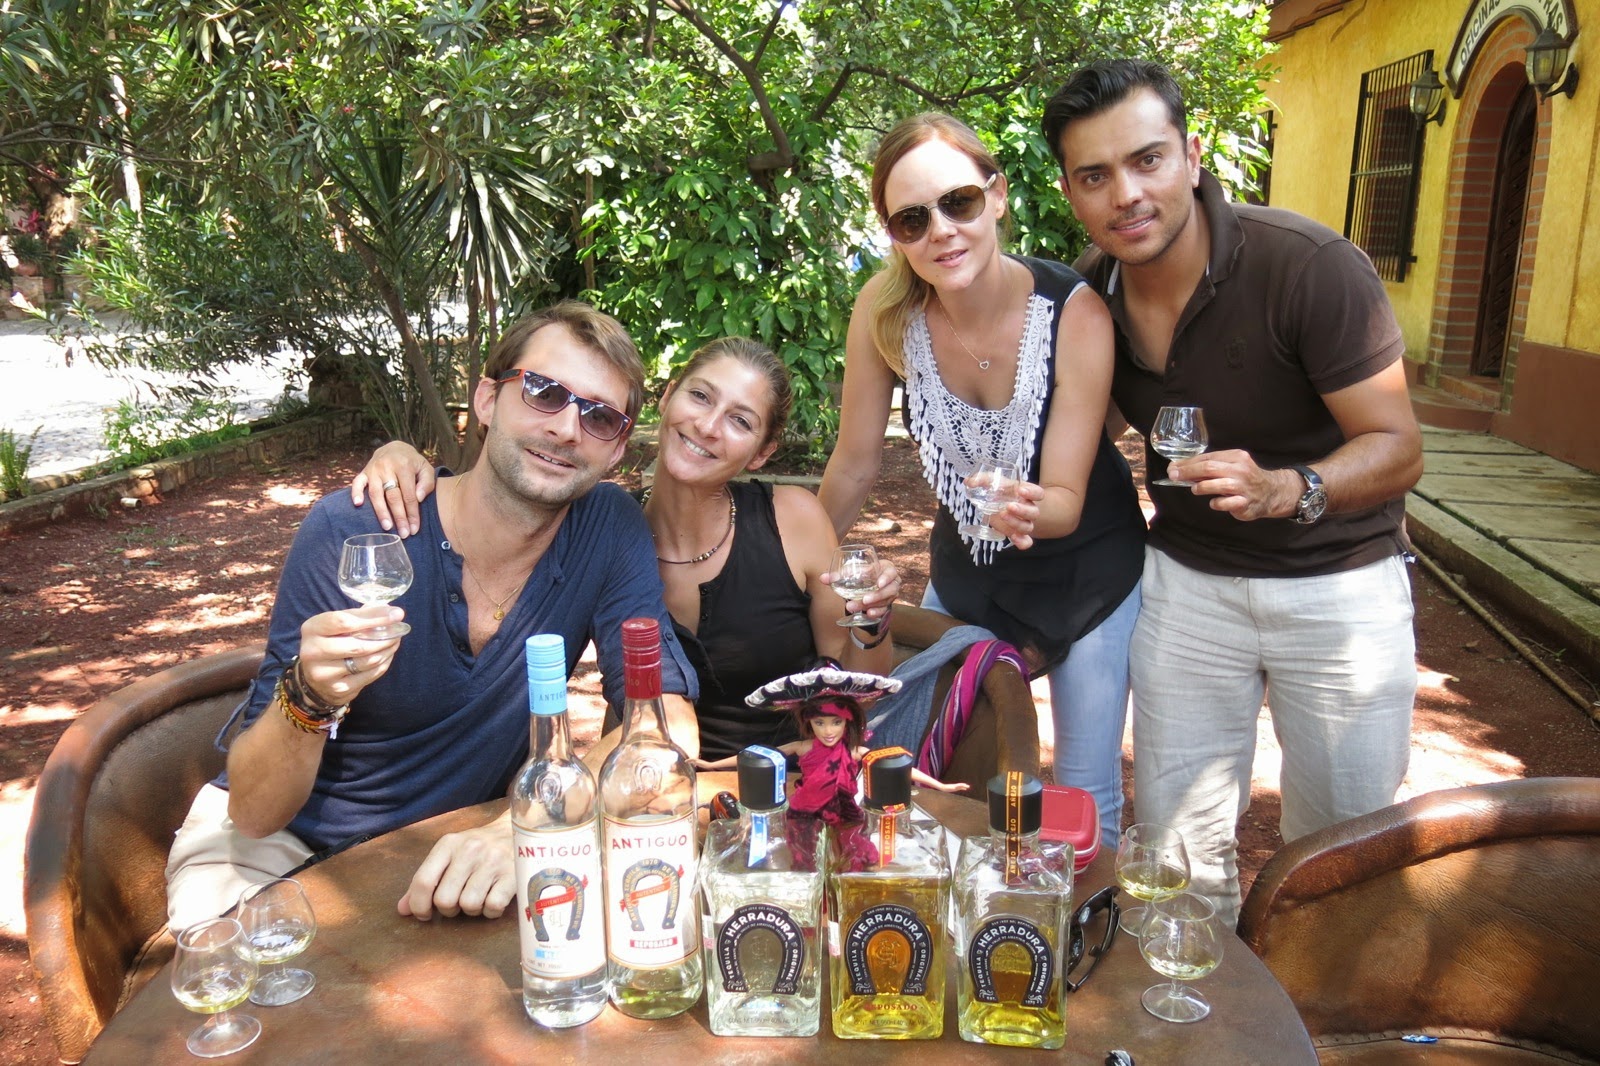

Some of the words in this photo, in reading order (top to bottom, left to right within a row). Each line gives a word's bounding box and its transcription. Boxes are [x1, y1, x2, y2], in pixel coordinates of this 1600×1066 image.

[1538, 0, 1563, 32] RAS
[612, 834, 687, 849] ANTIGUO
[1009, 818, 1017, 842] AEJO
[518, 844, 591, 858] ANTIGUO
[726, 912, 796, 940] HERRADURA
[853, 913, 923, 940] HERRADURA
[978, 925, 1045, 953] HERRADURA
[724, 947, 735, 979] TEQUILA
[785, 948, 798, 981] ORIGINAL
[851, 949, 862, 981] TEQUILA
[914, 949, 926, 981] ORIGINAL
[976, 957, 986, 988] TEQUILA
[1035, 962, 1047, 994] ORIGINAL
